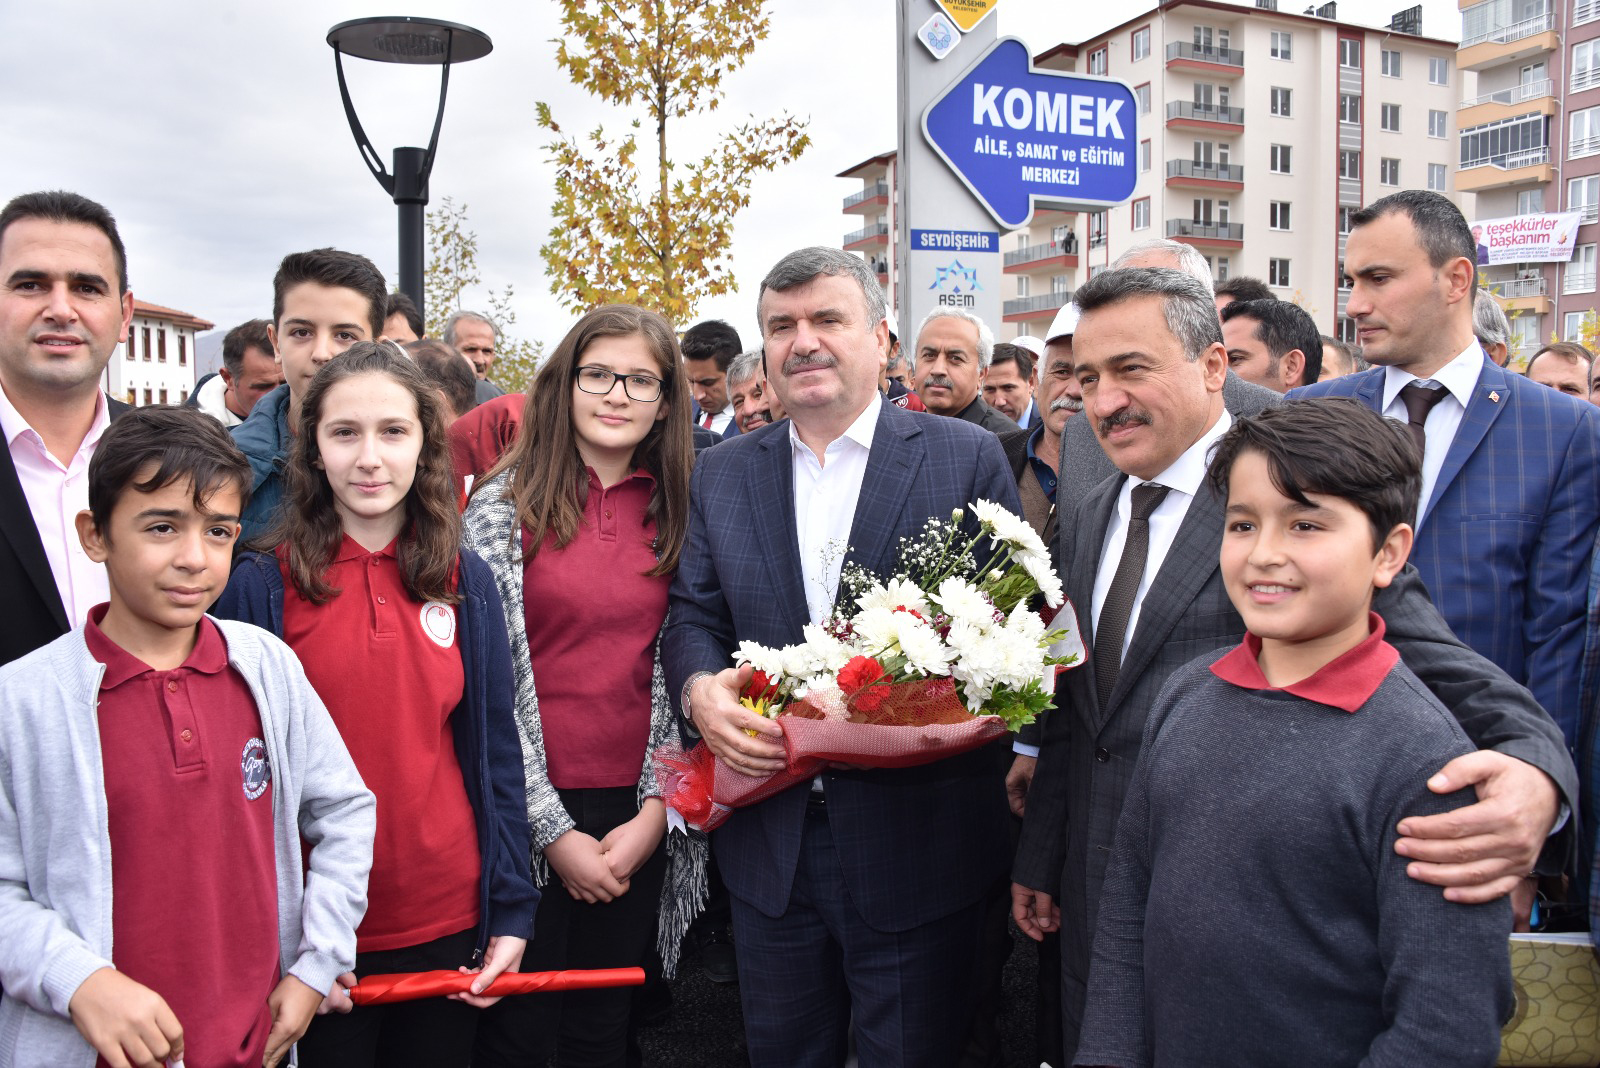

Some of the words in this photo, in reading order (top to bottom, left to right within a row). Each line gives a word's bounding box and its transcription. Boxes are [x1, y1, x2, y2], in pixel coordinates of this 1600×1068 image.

[973, 83, 1125, 140] KOMEK
[974, 135, 1012, 159] AİLE,
[1016, 141, 1058, 161] SANAT
[1062, 149, 1076, 163] ve
[1080, 145, 1125, 167] EĞİTİM
[1022, 165, 1080, 186] MERKEZİ
[1487, 217, 1558, 236] teşekkürler
[920, 231, 990, 251] SEYDİŞEHİR
[1490, 232, 1550, 248] başkanım
[939, 294, 975, 307] ASEM
